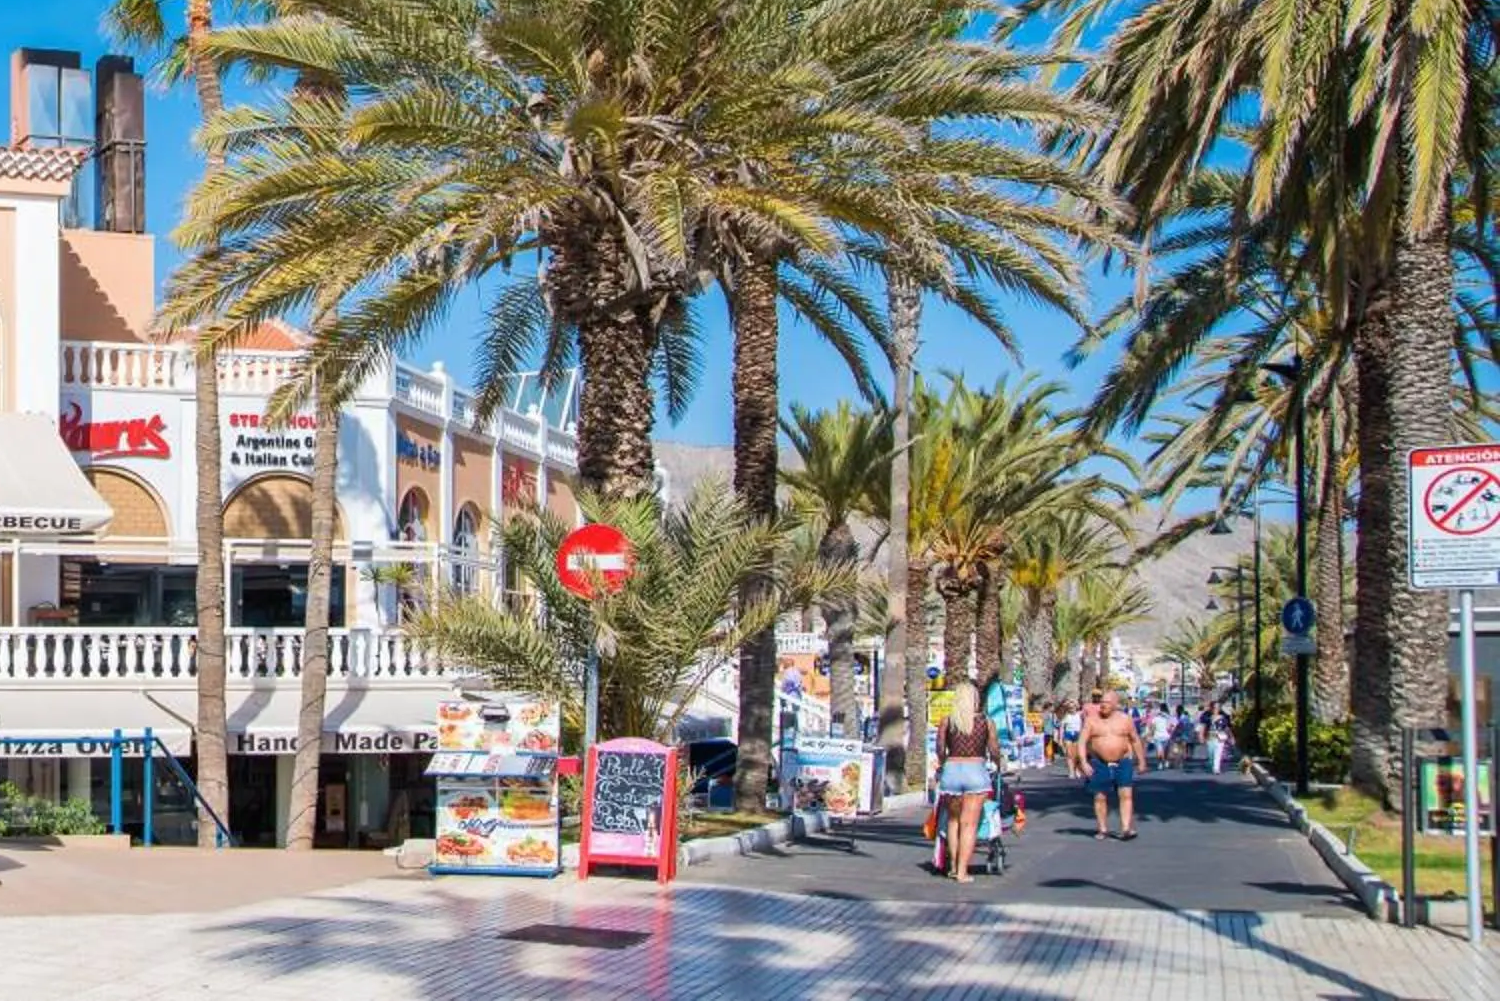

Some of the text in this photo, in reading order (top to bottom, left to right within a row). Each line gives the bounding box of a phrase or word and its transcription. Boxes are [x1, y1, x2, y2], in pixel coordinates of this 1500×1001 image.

[236, 434, 301, 451] Argentine
[245, 452, 287, 466] Italian
[2, 736, 64, 755] izza
[334, 732, 404, 750] Made
